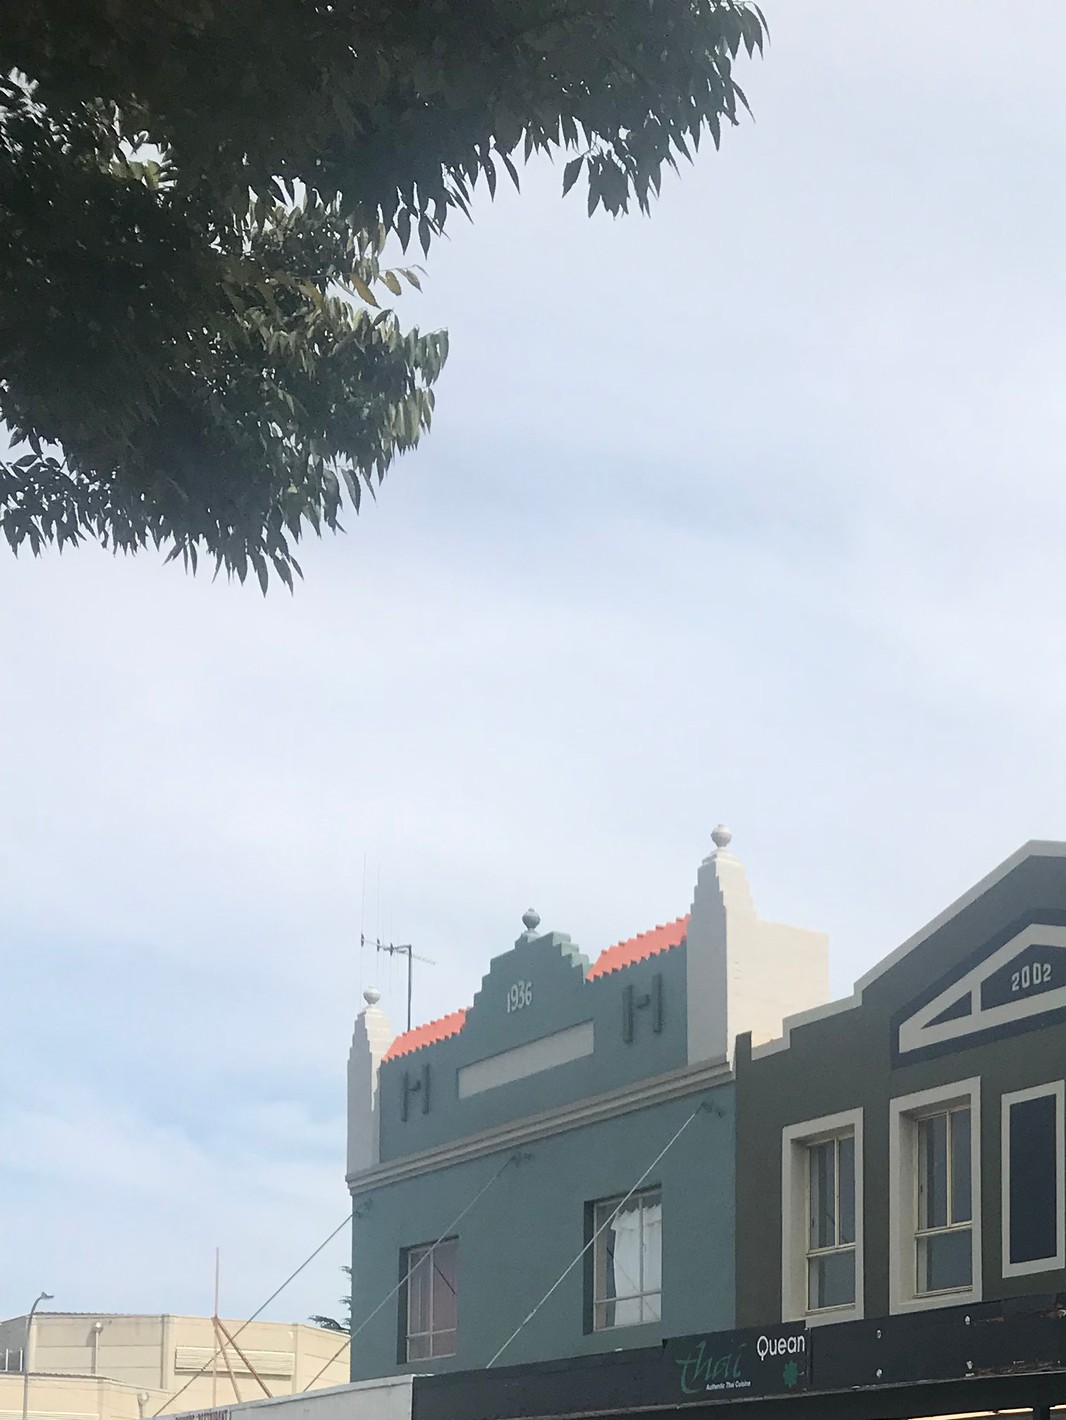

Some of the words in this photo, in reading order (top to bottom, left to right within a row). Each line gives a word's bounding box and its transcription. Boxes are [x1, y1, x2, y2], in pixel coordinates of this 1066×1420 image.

[1011, 962, 1052, 992] 2002
[506, 980, 533, 1013] 1936
[756, 1334, 806, 1361] Quean
